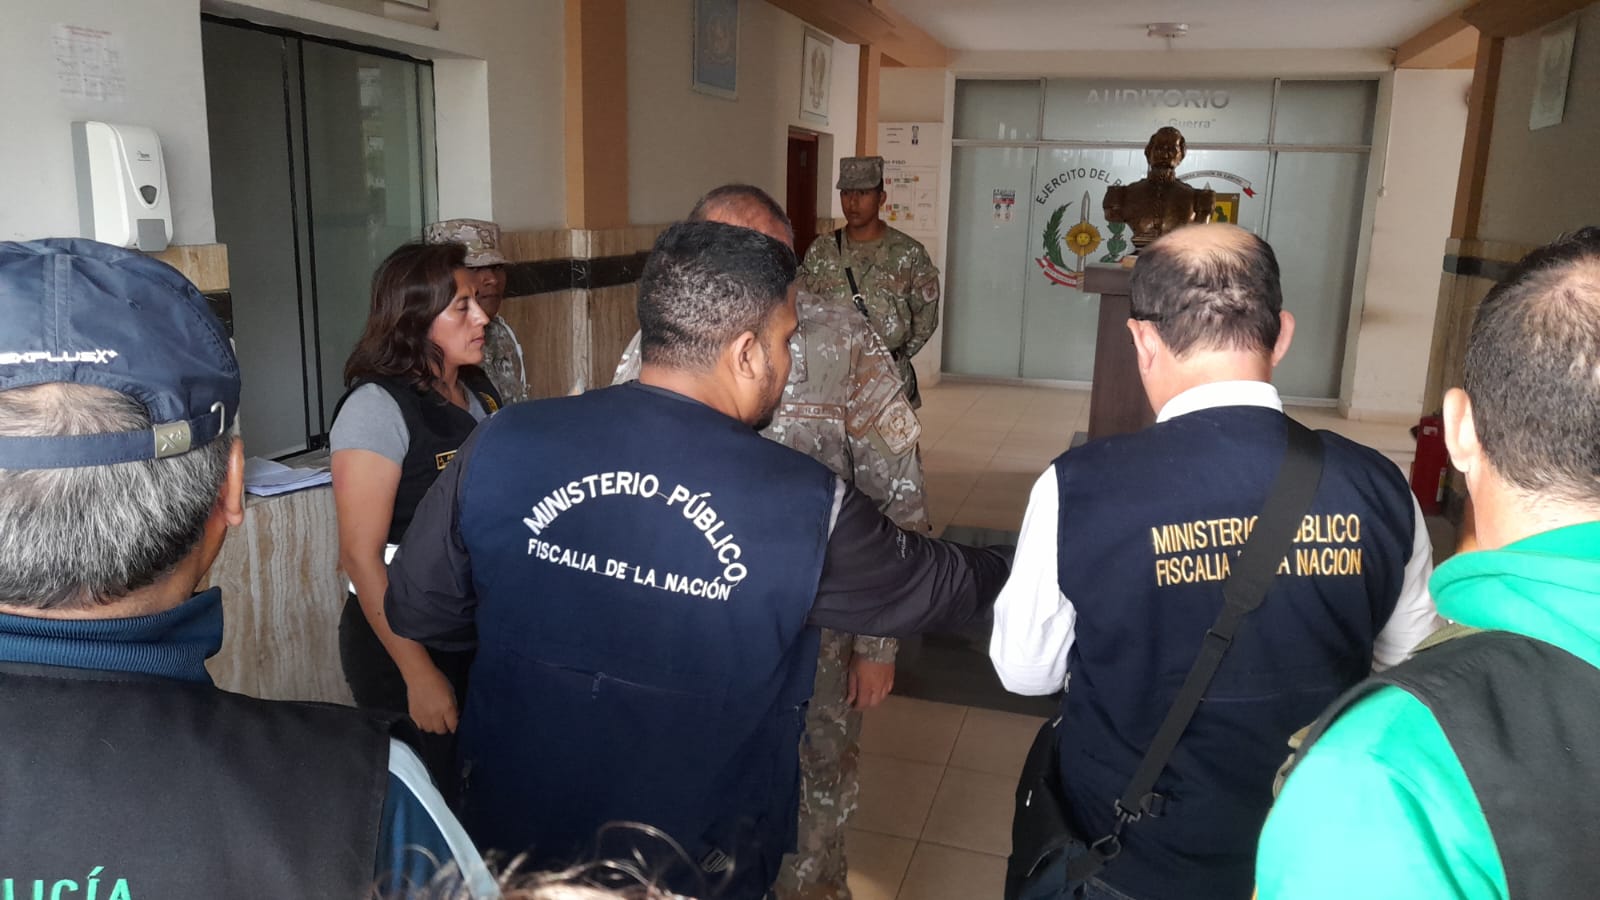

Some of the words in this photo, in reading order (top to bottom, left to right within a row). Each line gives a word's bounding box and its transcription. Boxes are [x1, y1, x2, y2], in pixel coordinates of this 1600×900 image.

[1087, 88, 1230, 109] AUDITORIO
[1036, 167, 1086, 205] EJERCITO
[1089, 168, 1111, 183] DEL
[523, 471, 659, 535] MINISTERIO
[667, 484, 748, 583] PÚBLICO
[1293, 513, 1361, 543] BLICO
[528, 538, 597, 573] FISCALIA
[605, 559, 628, 580] DE
[633, 566, 656, 587] LA
[664, 573, 732, 601] NACIÓN
[1156, 552, 1231, 587] FISCALIA
[1296, 548, 1362, 576] NACION
